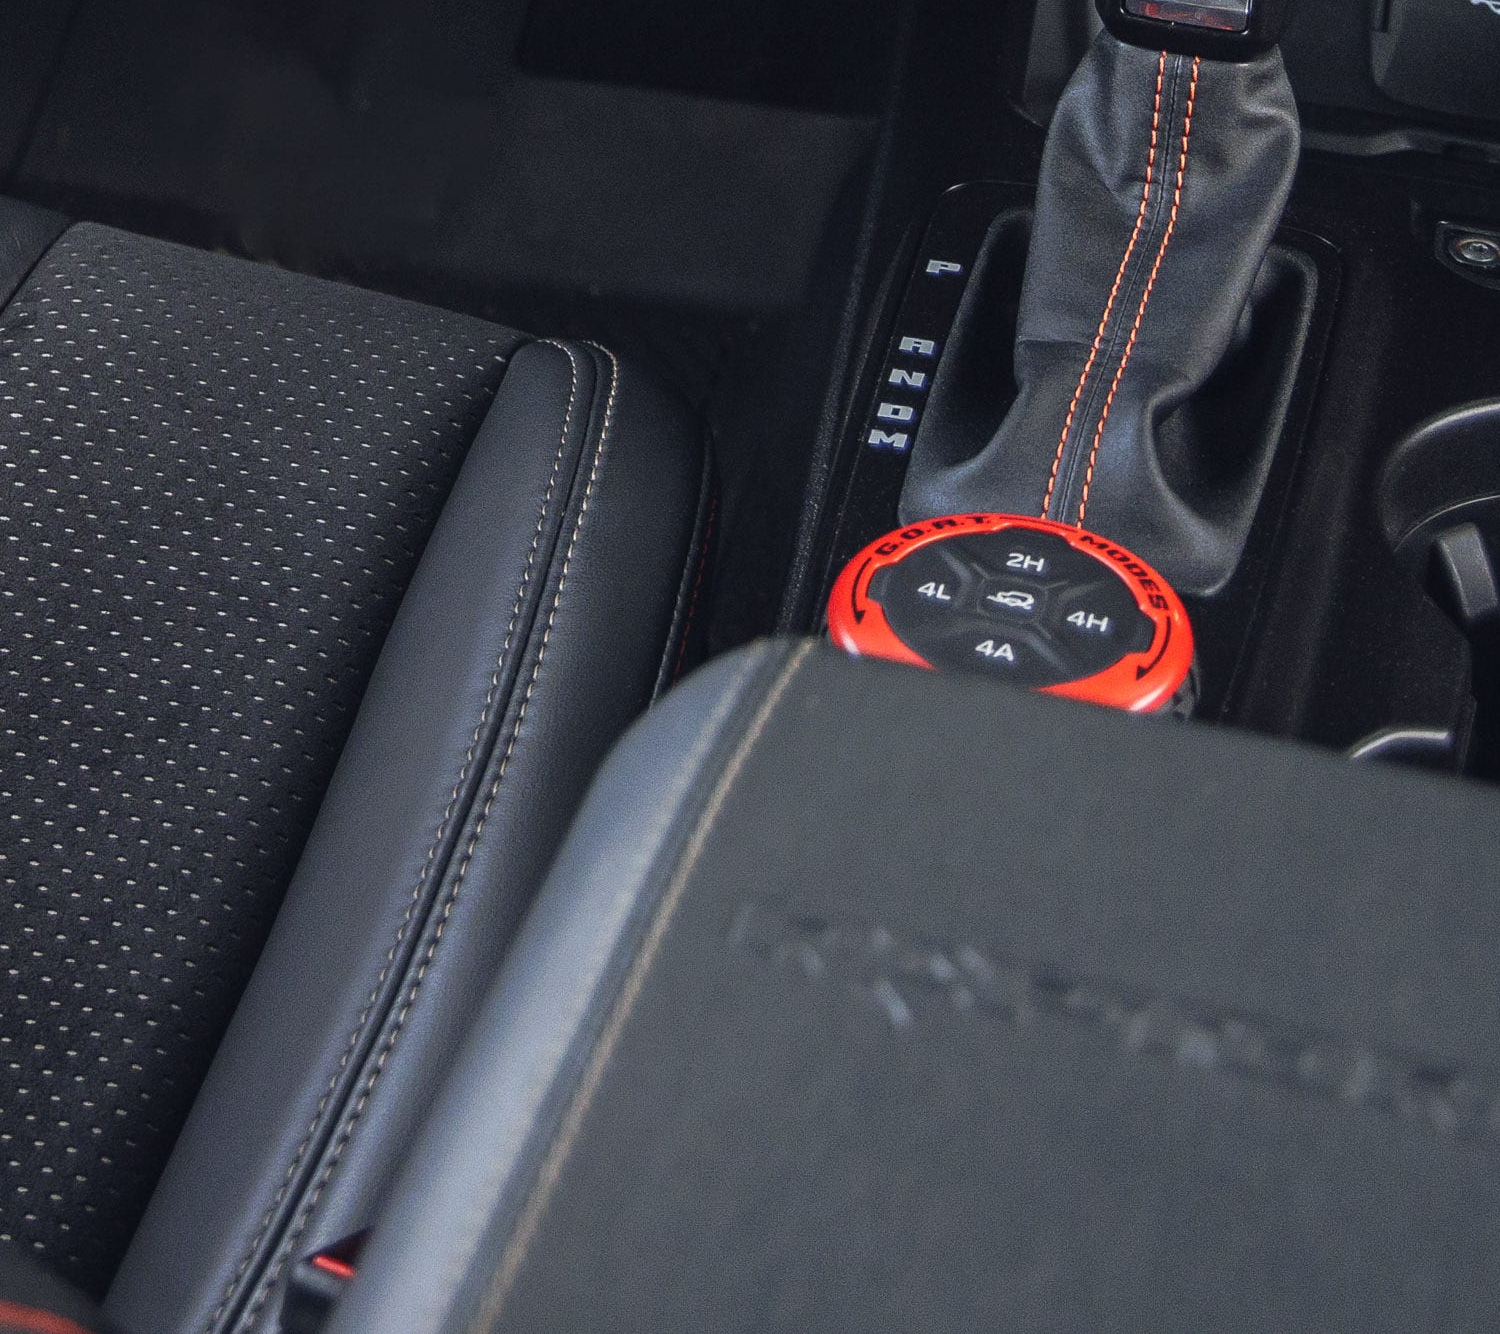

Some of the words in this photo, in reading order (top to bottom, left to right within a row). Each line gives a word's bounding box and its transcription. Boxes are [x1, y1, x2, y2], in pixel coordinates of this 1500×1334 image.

[926, 259, 961, 275] P
[888, 368, 926, 387] N
[868, 429, 908, 448] M
[1005, 552, 1046, 572] 2H
[1078, 534, 1169, 611] MODES
[917, 581, 952, 600] 4L
[1066, 610, 1110, 633] 4H
[974, 639, 1015, 662] 4A
